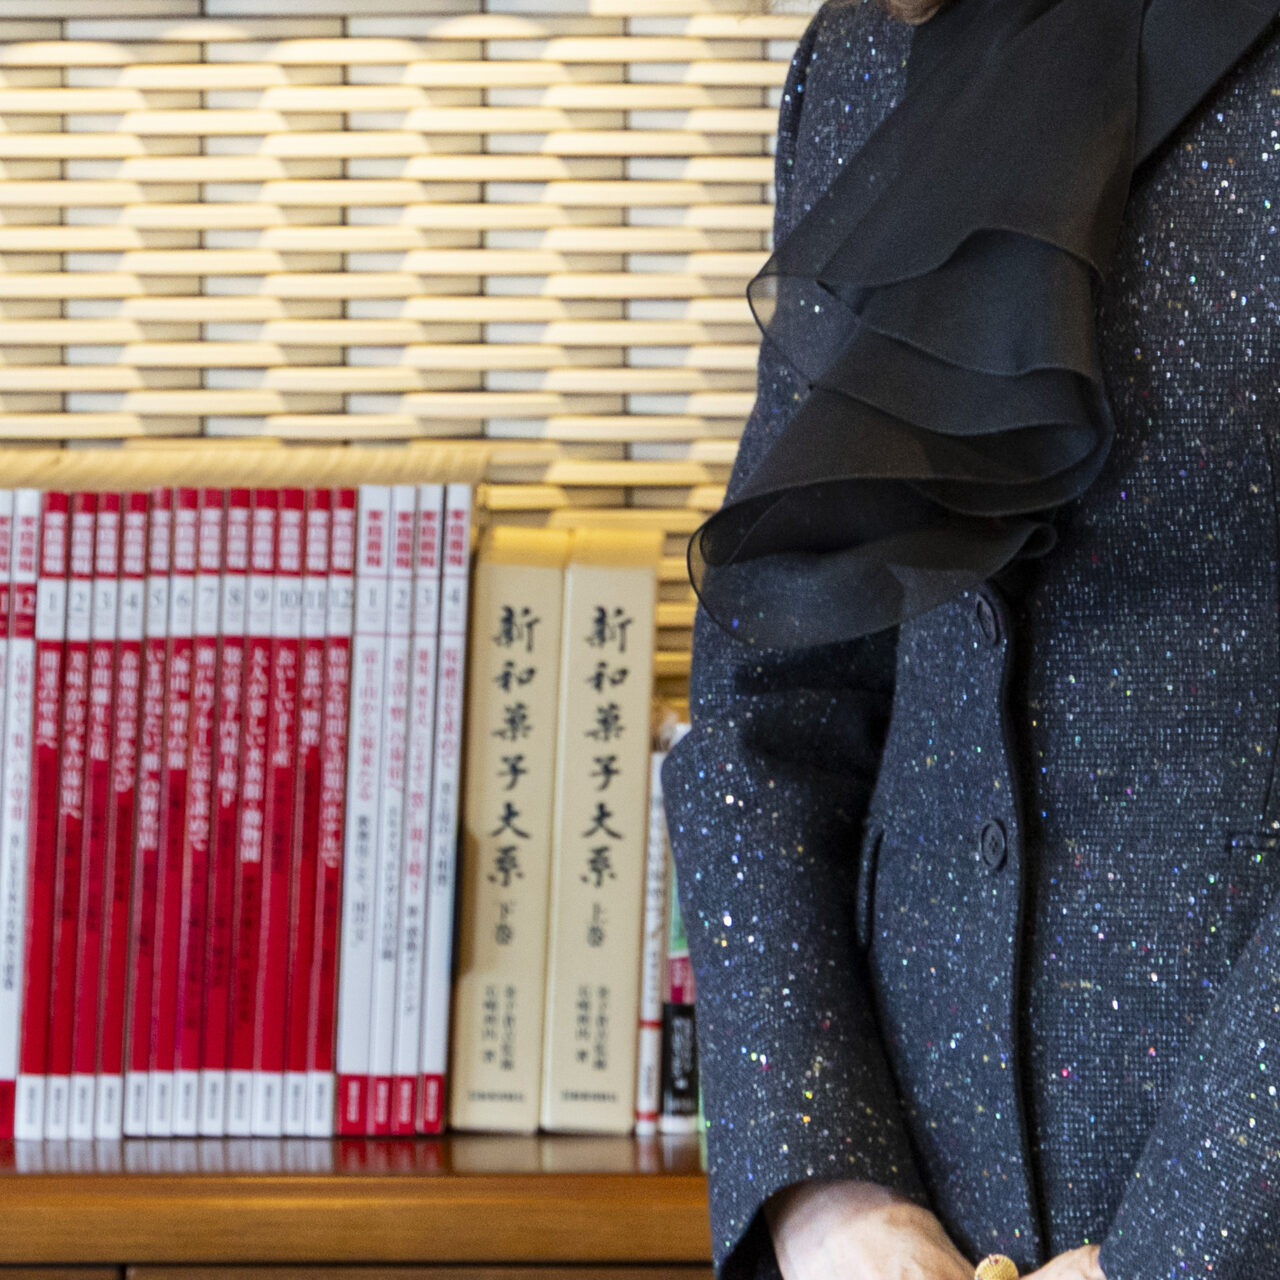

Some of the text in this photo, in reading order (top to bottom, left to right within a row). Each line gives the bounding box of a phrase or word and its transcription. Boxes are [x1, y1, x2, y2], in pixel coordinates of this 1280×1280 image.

[14, 592, 36, 615] 12
[487, 606, 541, 888] 新和菓子大系
[580, 606, 633, 888] 新和菓子大系
